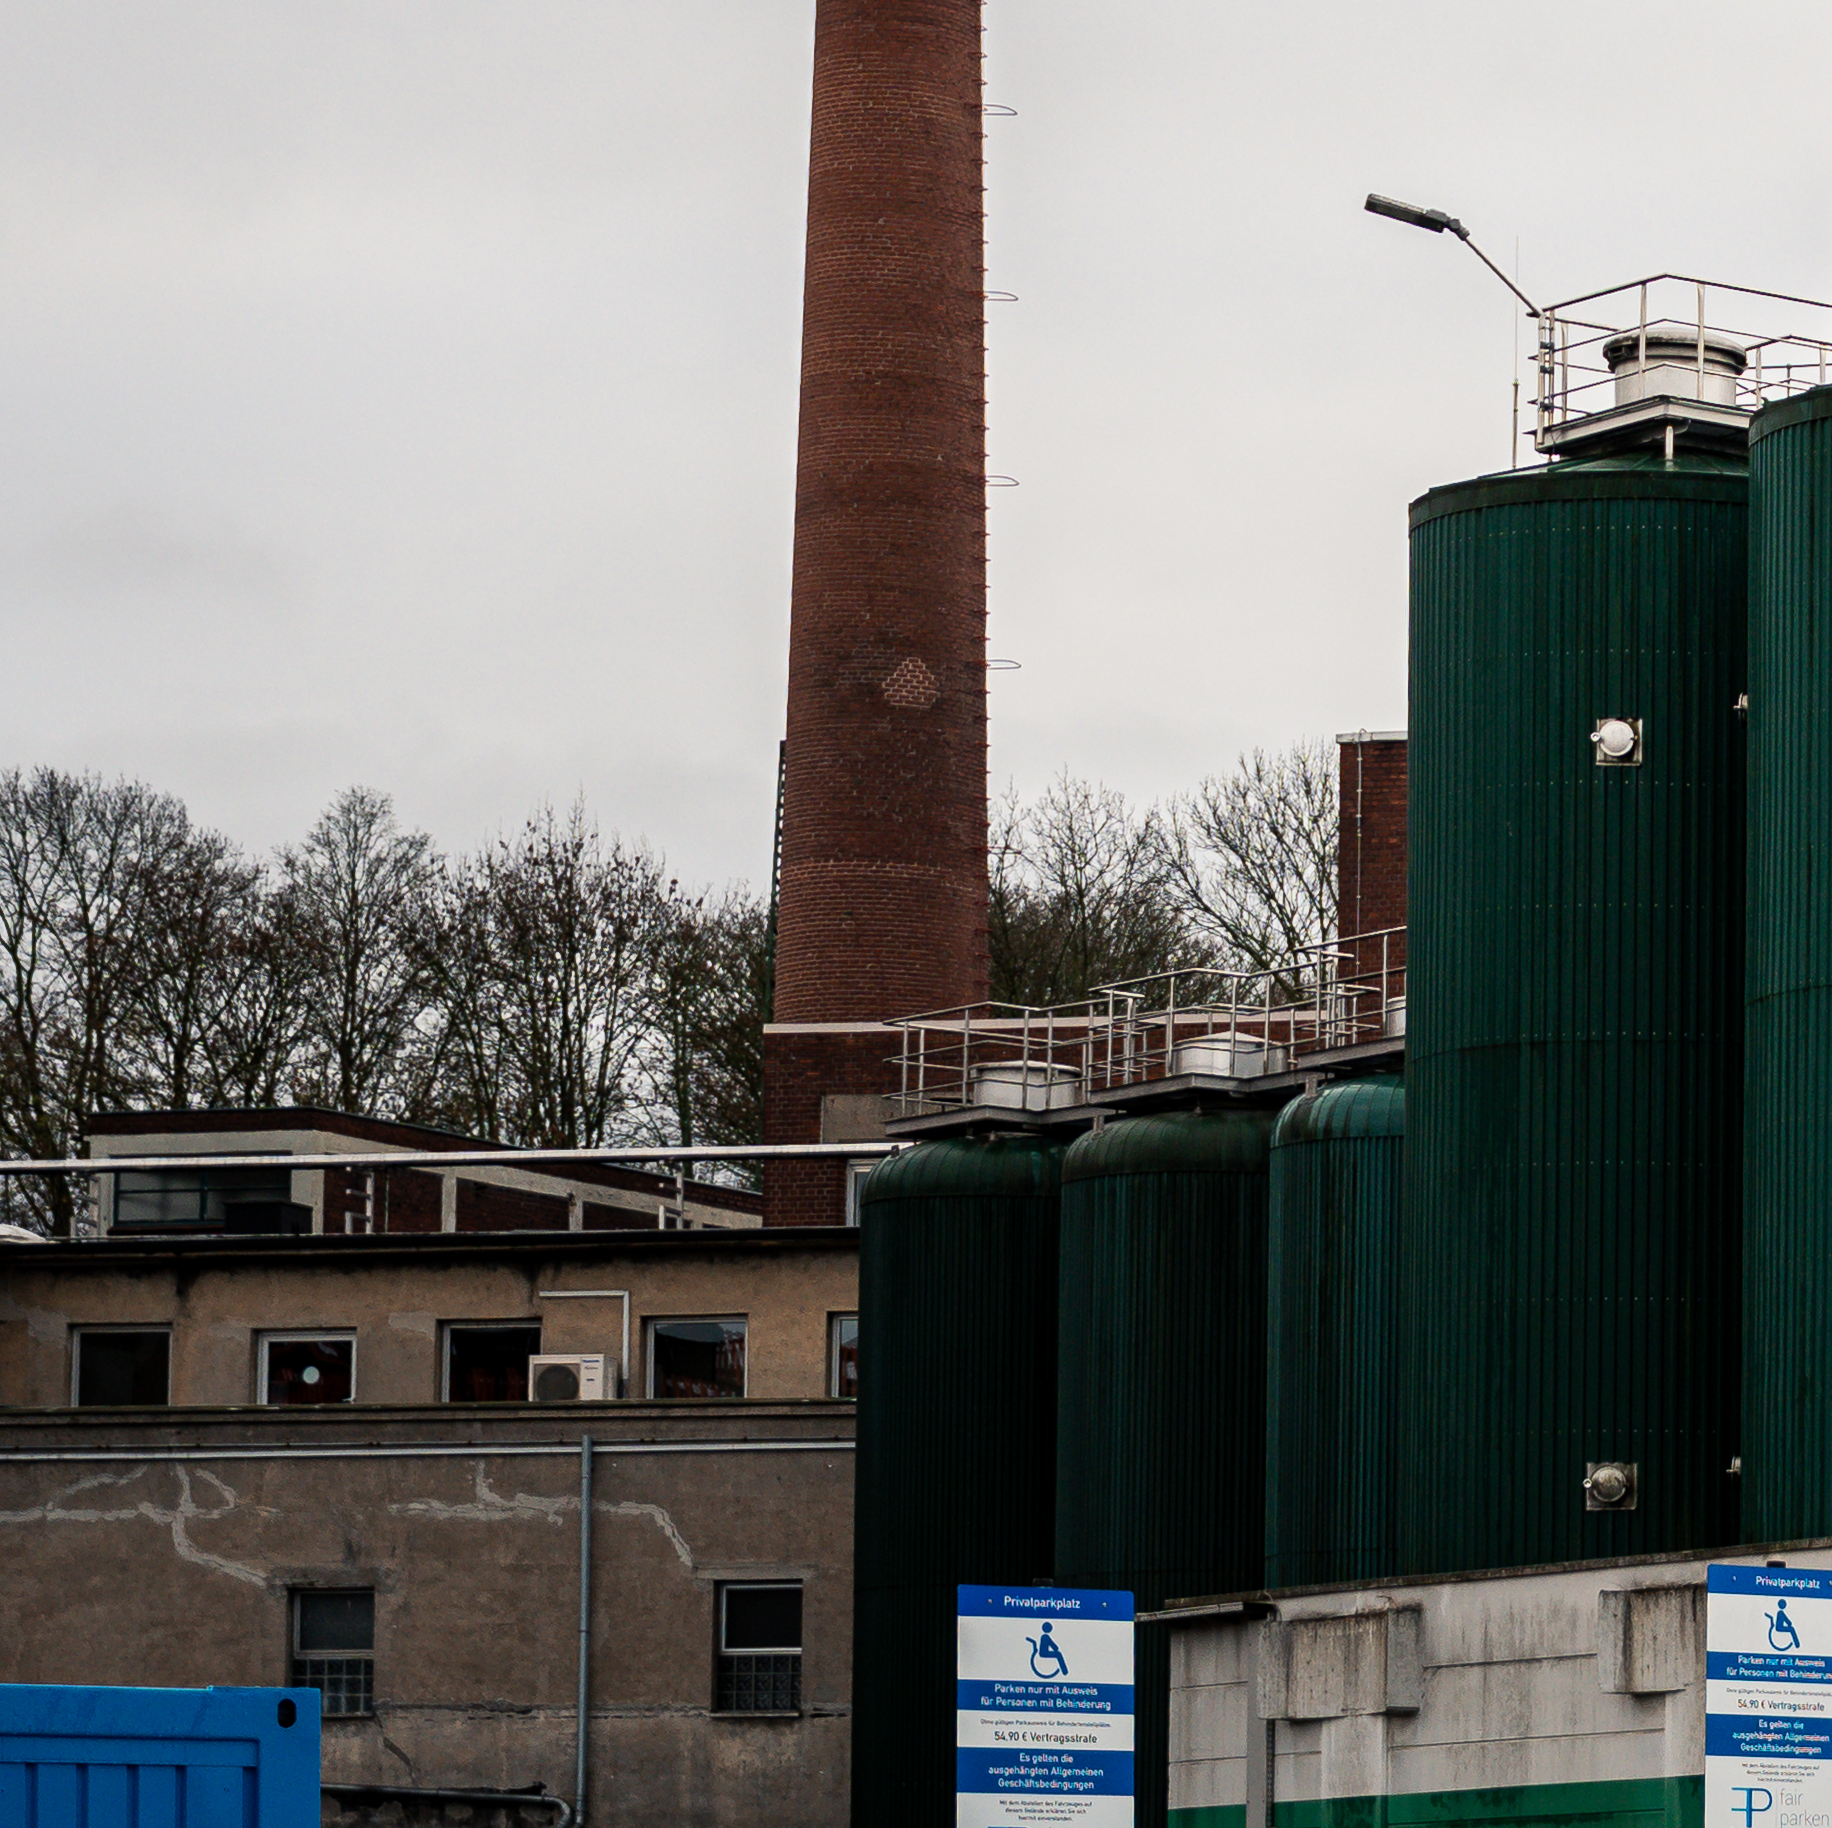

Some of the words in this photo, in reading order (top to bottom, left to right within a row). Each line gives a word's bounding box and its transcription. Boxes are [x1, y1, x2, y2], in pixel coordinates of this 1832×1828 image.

[1755, 1575, 1820, 1589] Privatparkplatz
[1004, 1595, 1081, 1610] Privatparkplatz
[1738, 1655, 1764, 1665] Parken
[1780, 1657, 1793, 1666] mit
[1726, 1666, 1737, 1676] für
[1739, 1667, 1774, 1677] Personen
[1776, 1669, 1788, 1678] mit
[995, 1683, 1026, 1693] Parken
[1028, 1686, 1043, 1694] nur
[1045, 1685, 1060, 1694] mit
[1061, 1685, 1098, 1696] Ausweis
[981, 1696, 994, 1706] für
[996, 1696, 1038, 1707] Personen
[1040, 1697, 1054, 1707] mit
[1056, 1698, 1111, 1710] Behinderung
[1767, 1700, 1825, 1712] Vertragsstrafe
[1759, 1719, 1768, 1728] Es
[994, 1731, 1020, 1742] 54.90
[1022, 1732, 1028, 1742] €
[1029, 1732, 1098, 1745] Vertragsstrafe
[1019, 1753, 1031, 1762] Es
[1032, 1753, 1058, 1765] gelten
[1060, 1754, 1074, 1763] die
[988, 1765, 1048, 1776] ausgehängten
[1050, 1766, 1104, 1777] Allgemeinen
[998, 1778, 1095, 1791] Geschäftsbedingungen
[1780, 1788, 1804, 1806] fair
[1780, 1810, 1830, 1828] parken
